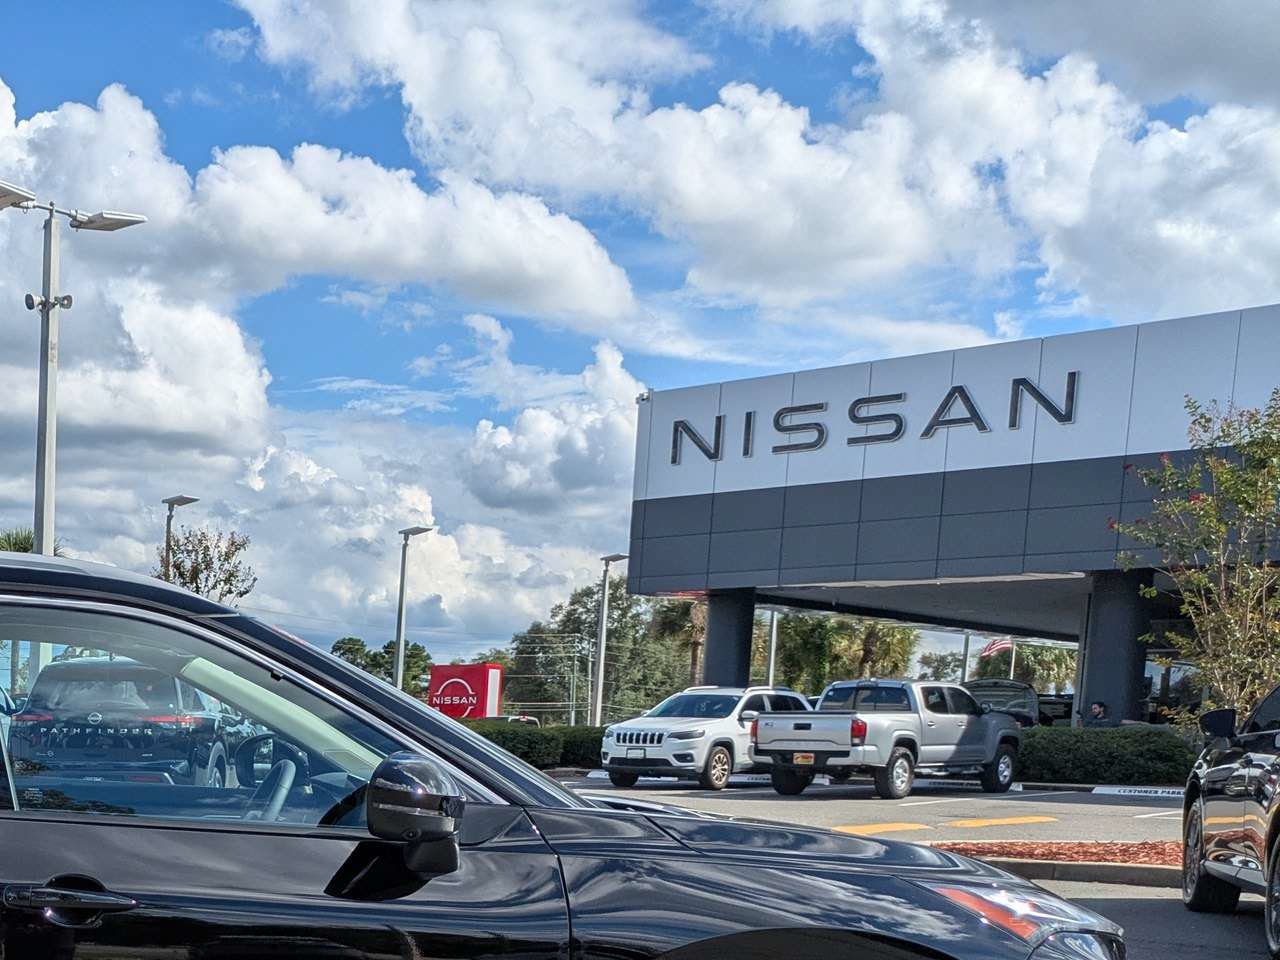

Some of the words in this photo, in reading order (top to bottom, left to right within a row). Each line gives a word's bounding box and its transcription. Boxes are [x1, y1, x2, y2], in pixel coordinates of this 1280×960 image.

[670, 370, 1080, 466] NISSAN
[432, 696, 477, 704] NISSAN
[40, 727, 153, 735] PATHFINDER
